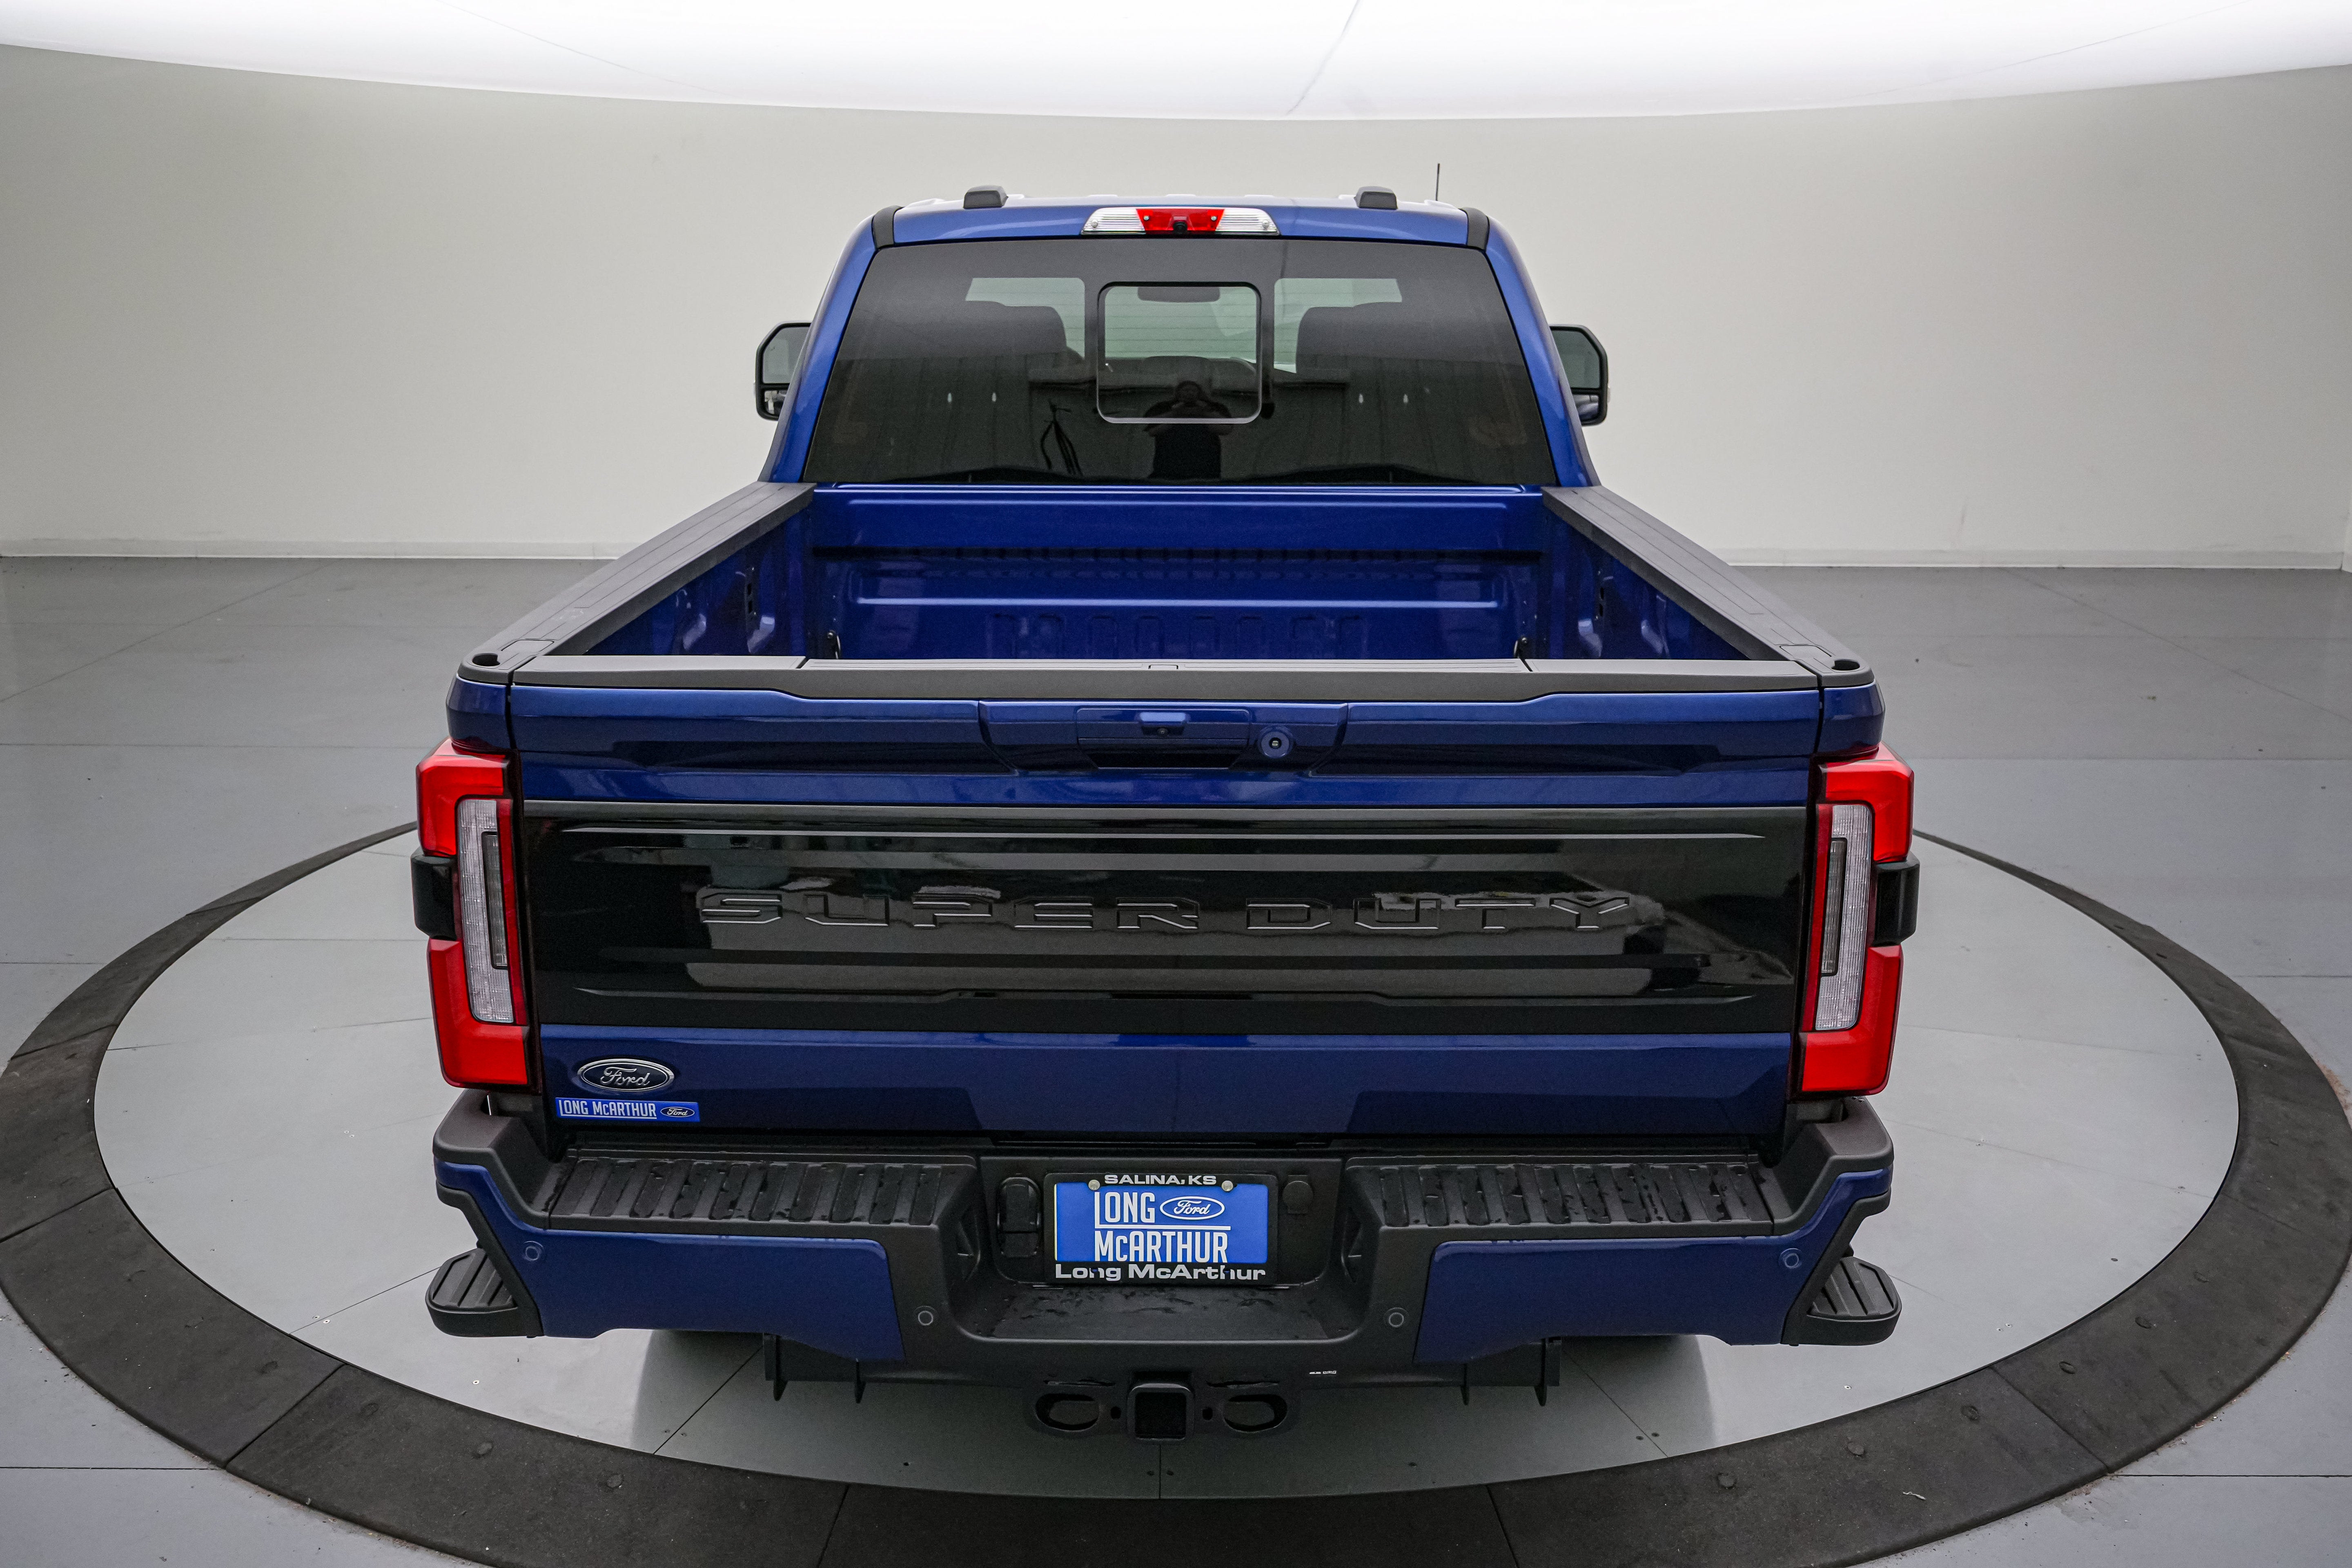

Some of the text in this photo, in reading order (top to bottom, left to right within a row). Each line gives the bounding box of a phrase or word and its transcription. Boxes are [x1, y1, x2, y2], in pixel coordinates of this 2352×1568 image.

[700, 892, 1630, 930] SUPER DUTY
[600, 1067, 651, 1086] Ford
[559, 1100, 688, 1117] LONG McARTHUR Ford
[1104, 1174, 1217, 1185] SALINA, KS
[1094, 1192, 1211, 1229] LONG Ford
[1094, 1230, 1228, 1263] McARTHUR
[1055, 1263, 1266, 1282] Long McArthur
